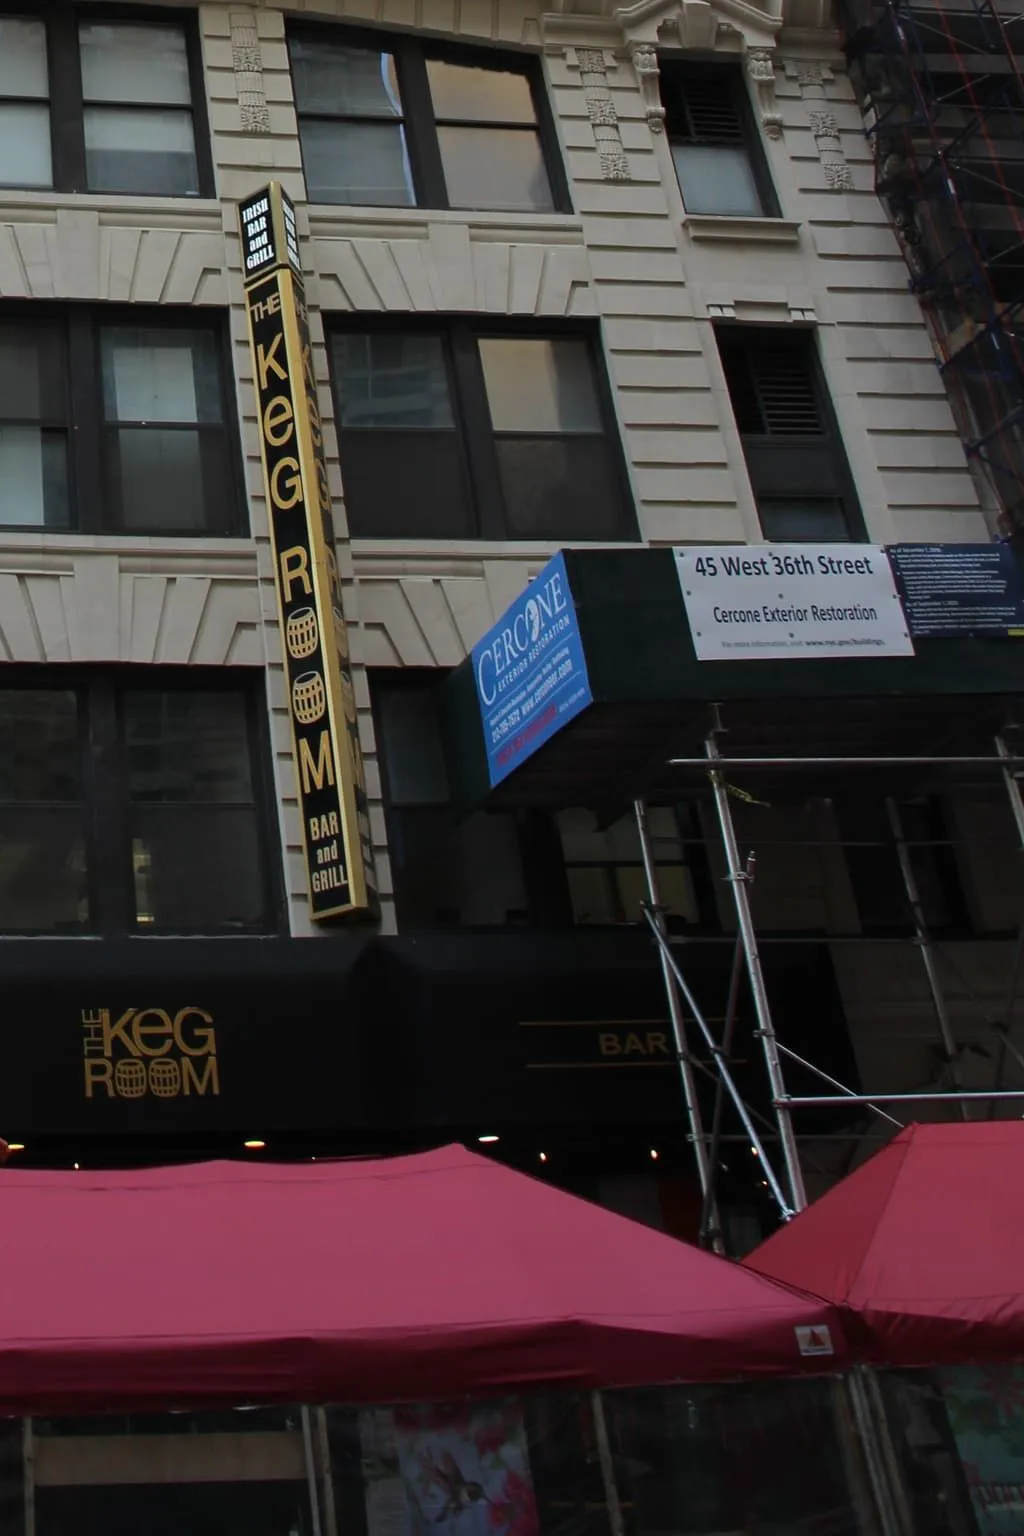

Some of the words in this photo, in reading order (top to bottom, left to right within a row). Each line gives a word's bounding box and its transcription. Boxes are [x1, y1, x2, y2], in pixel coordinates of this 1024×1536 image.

[242, 197, 269, 223] IRISH
[247, 216, 267, 237] BAR
[249, 231, 269, 252] and
[246, 244, 275, 269] GRILL
[249, 292, 281, 323] THE
[695, 556, 718, 577] 45
[720, 557, 770, 577] West
[771, 555, 815, 576] 36th
[817, 555, 874, 575] Street
[713, 606, 761, 624] Cercone
[764, 605, 809, 623] Exterior
[812, 603, 878, 622] Restoration
[497, 658, 528, 693] EXTERIOR
[528, 614, 570, 664] RESTORATION
[309, 811, 340, 841] BAR
[316, 839, 339, 864] and
[312, 866, 349, 894] GRILL
[83, 1008, 104, 1057] THE
[598, 1031, 669, 1057] BAR
